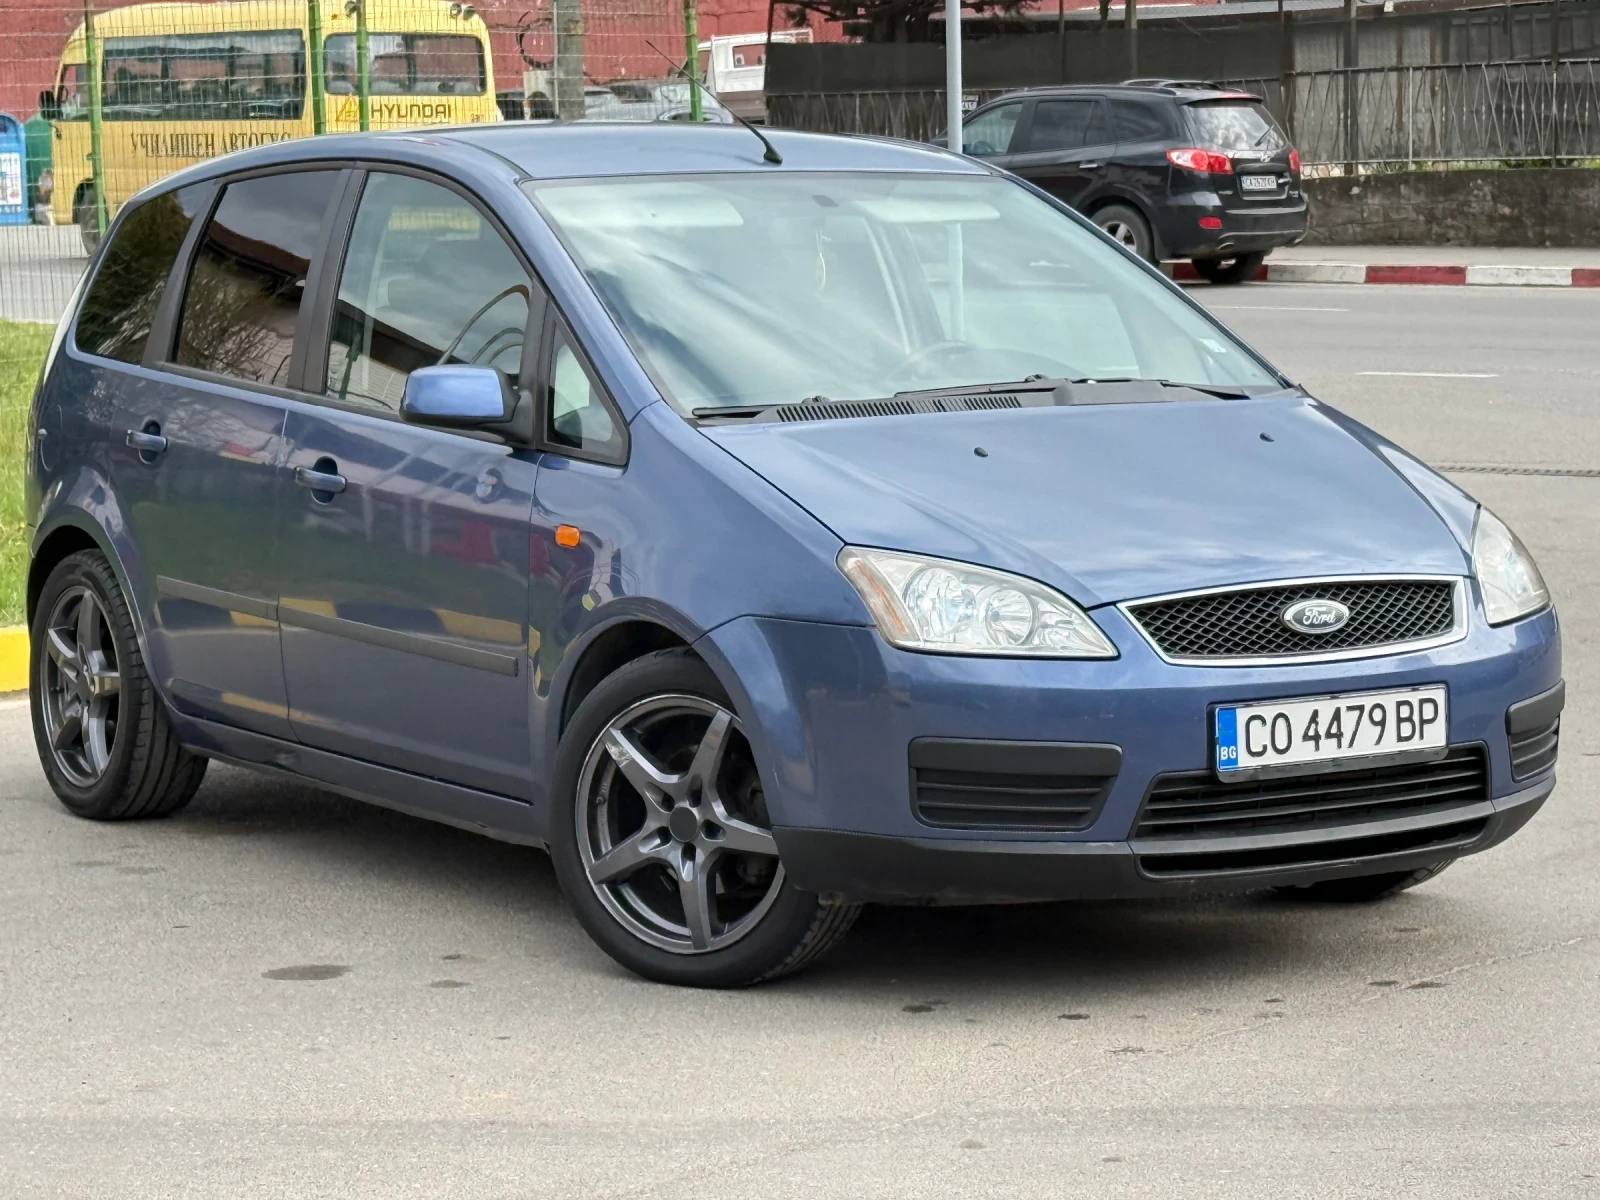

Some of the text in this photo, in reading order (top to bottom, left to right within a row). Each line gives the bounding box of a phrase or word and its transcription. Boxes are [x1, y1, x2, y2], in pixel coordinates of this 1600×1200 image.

[371, 104, 452, 119] HYUNDAI
[1302, 606, 1336, 625] Ford
[1245, 698, 1439, 758] CO 4479 BP
[1220, 745, 1237, 760] BG
